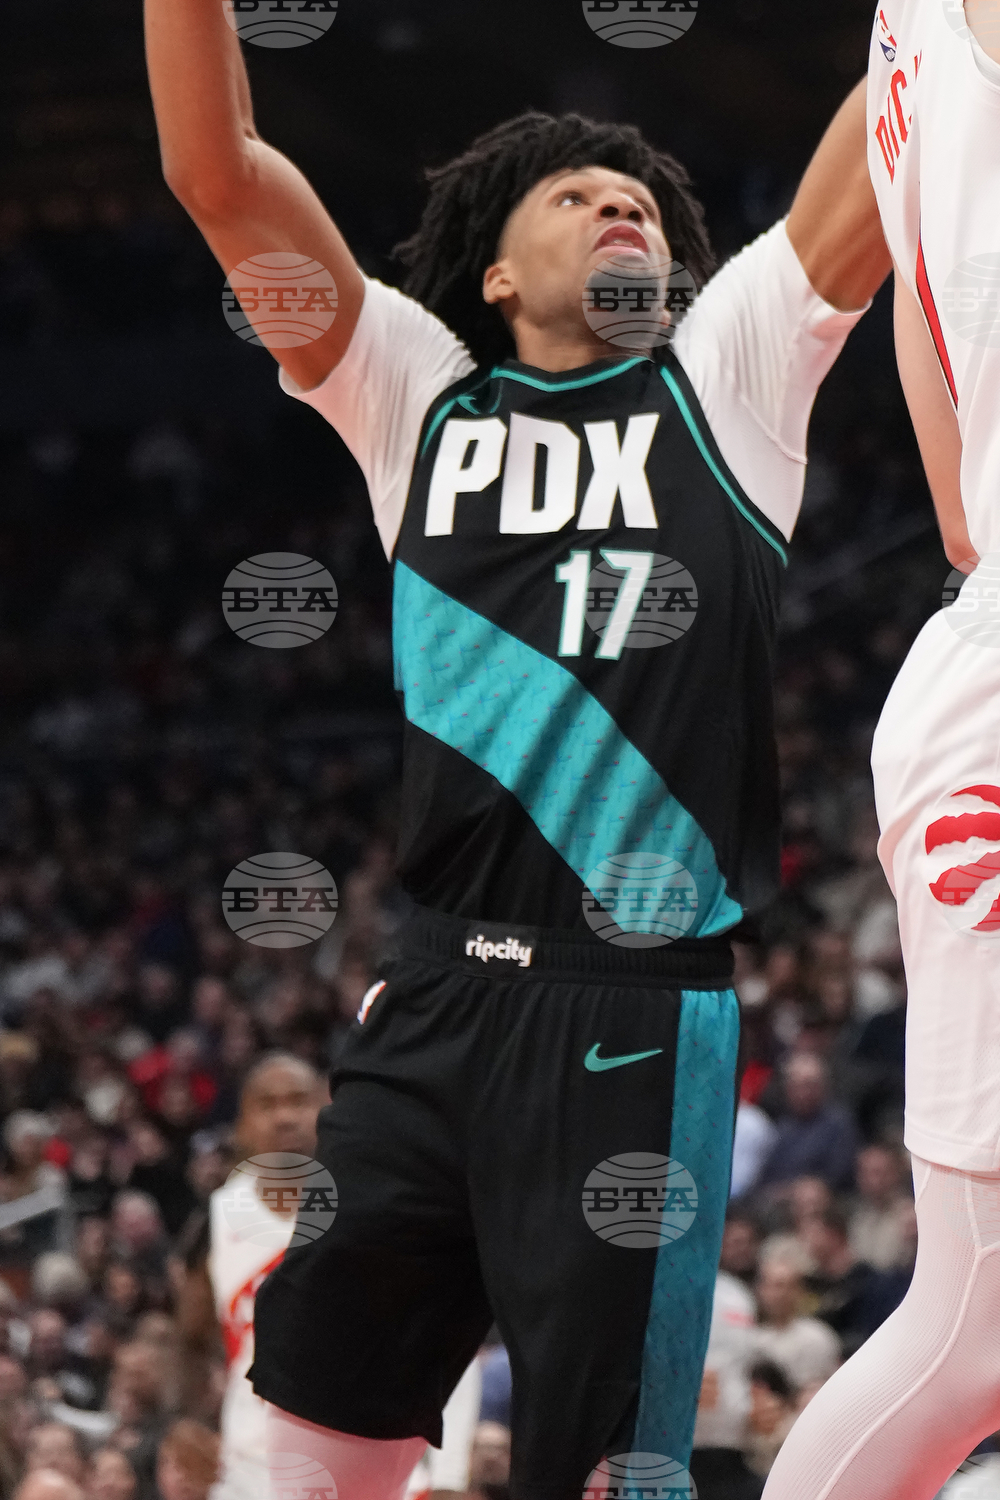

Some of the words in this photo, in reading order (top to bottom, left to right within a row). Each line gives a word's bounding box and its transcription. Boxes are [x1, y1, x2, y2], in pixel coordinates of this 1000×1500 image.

[424, 411, 660, 537] PDX
[555, 548, 654, 661] 17
[465, 933, 533, 969] ripcity
